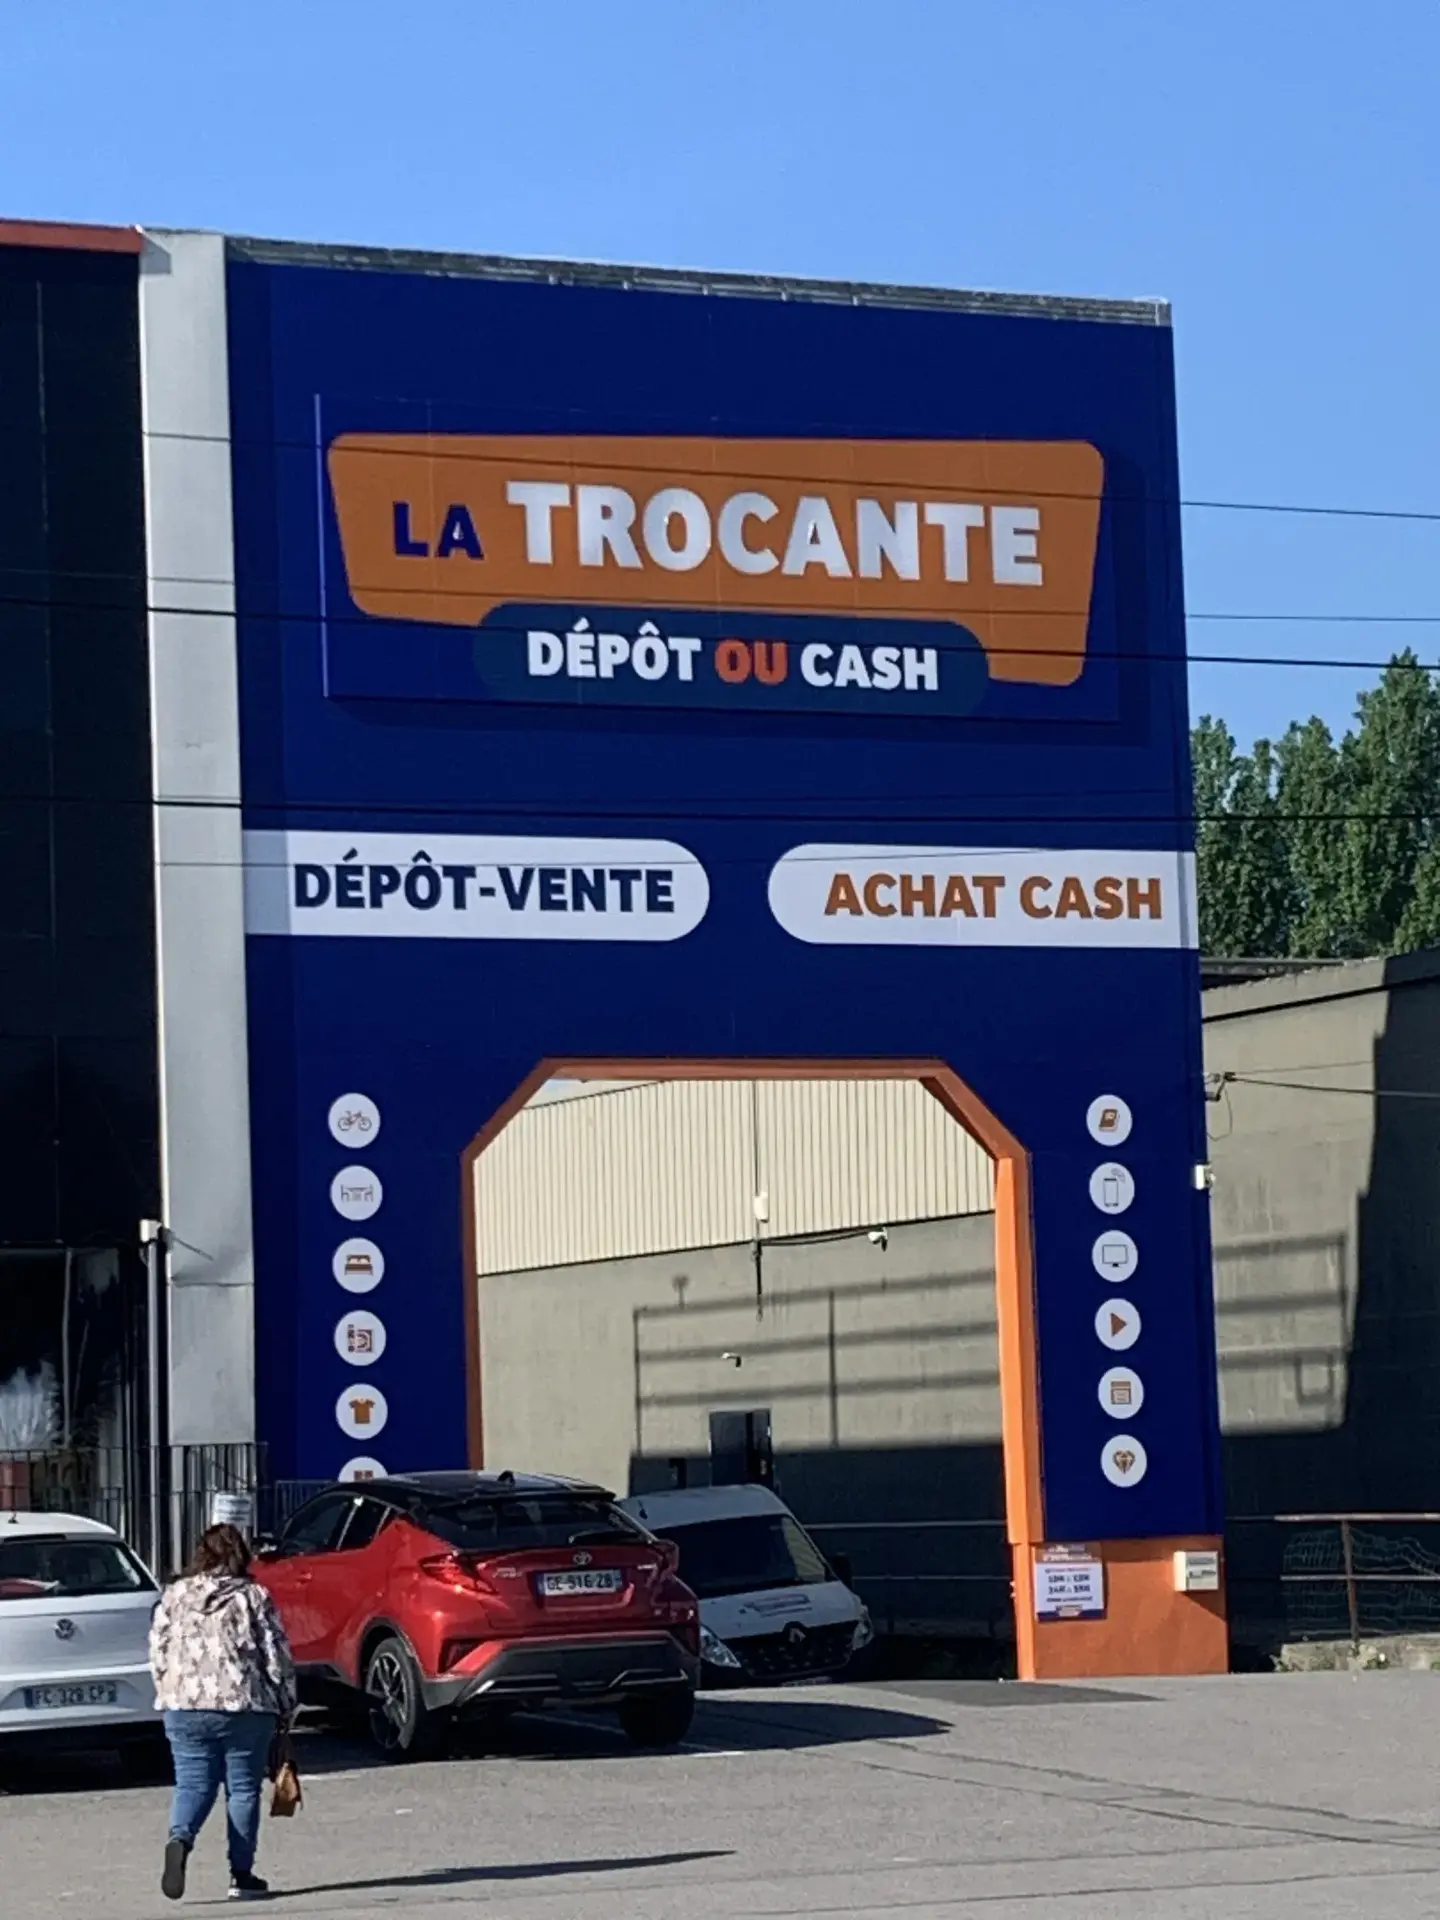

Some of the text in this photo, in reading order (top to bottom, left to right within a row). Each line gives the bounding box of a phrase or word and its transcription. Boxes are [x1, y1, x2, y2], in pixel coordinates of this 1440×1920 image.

[394, 481, 1043, 586] LA TROCANTE
[527, 617, 938, 691] DÉPÔT OU CASH
[293, 847, 675, 913] DÉPÔT-VENTE
[824, 873, 1162, 920] ACHAT CASH
